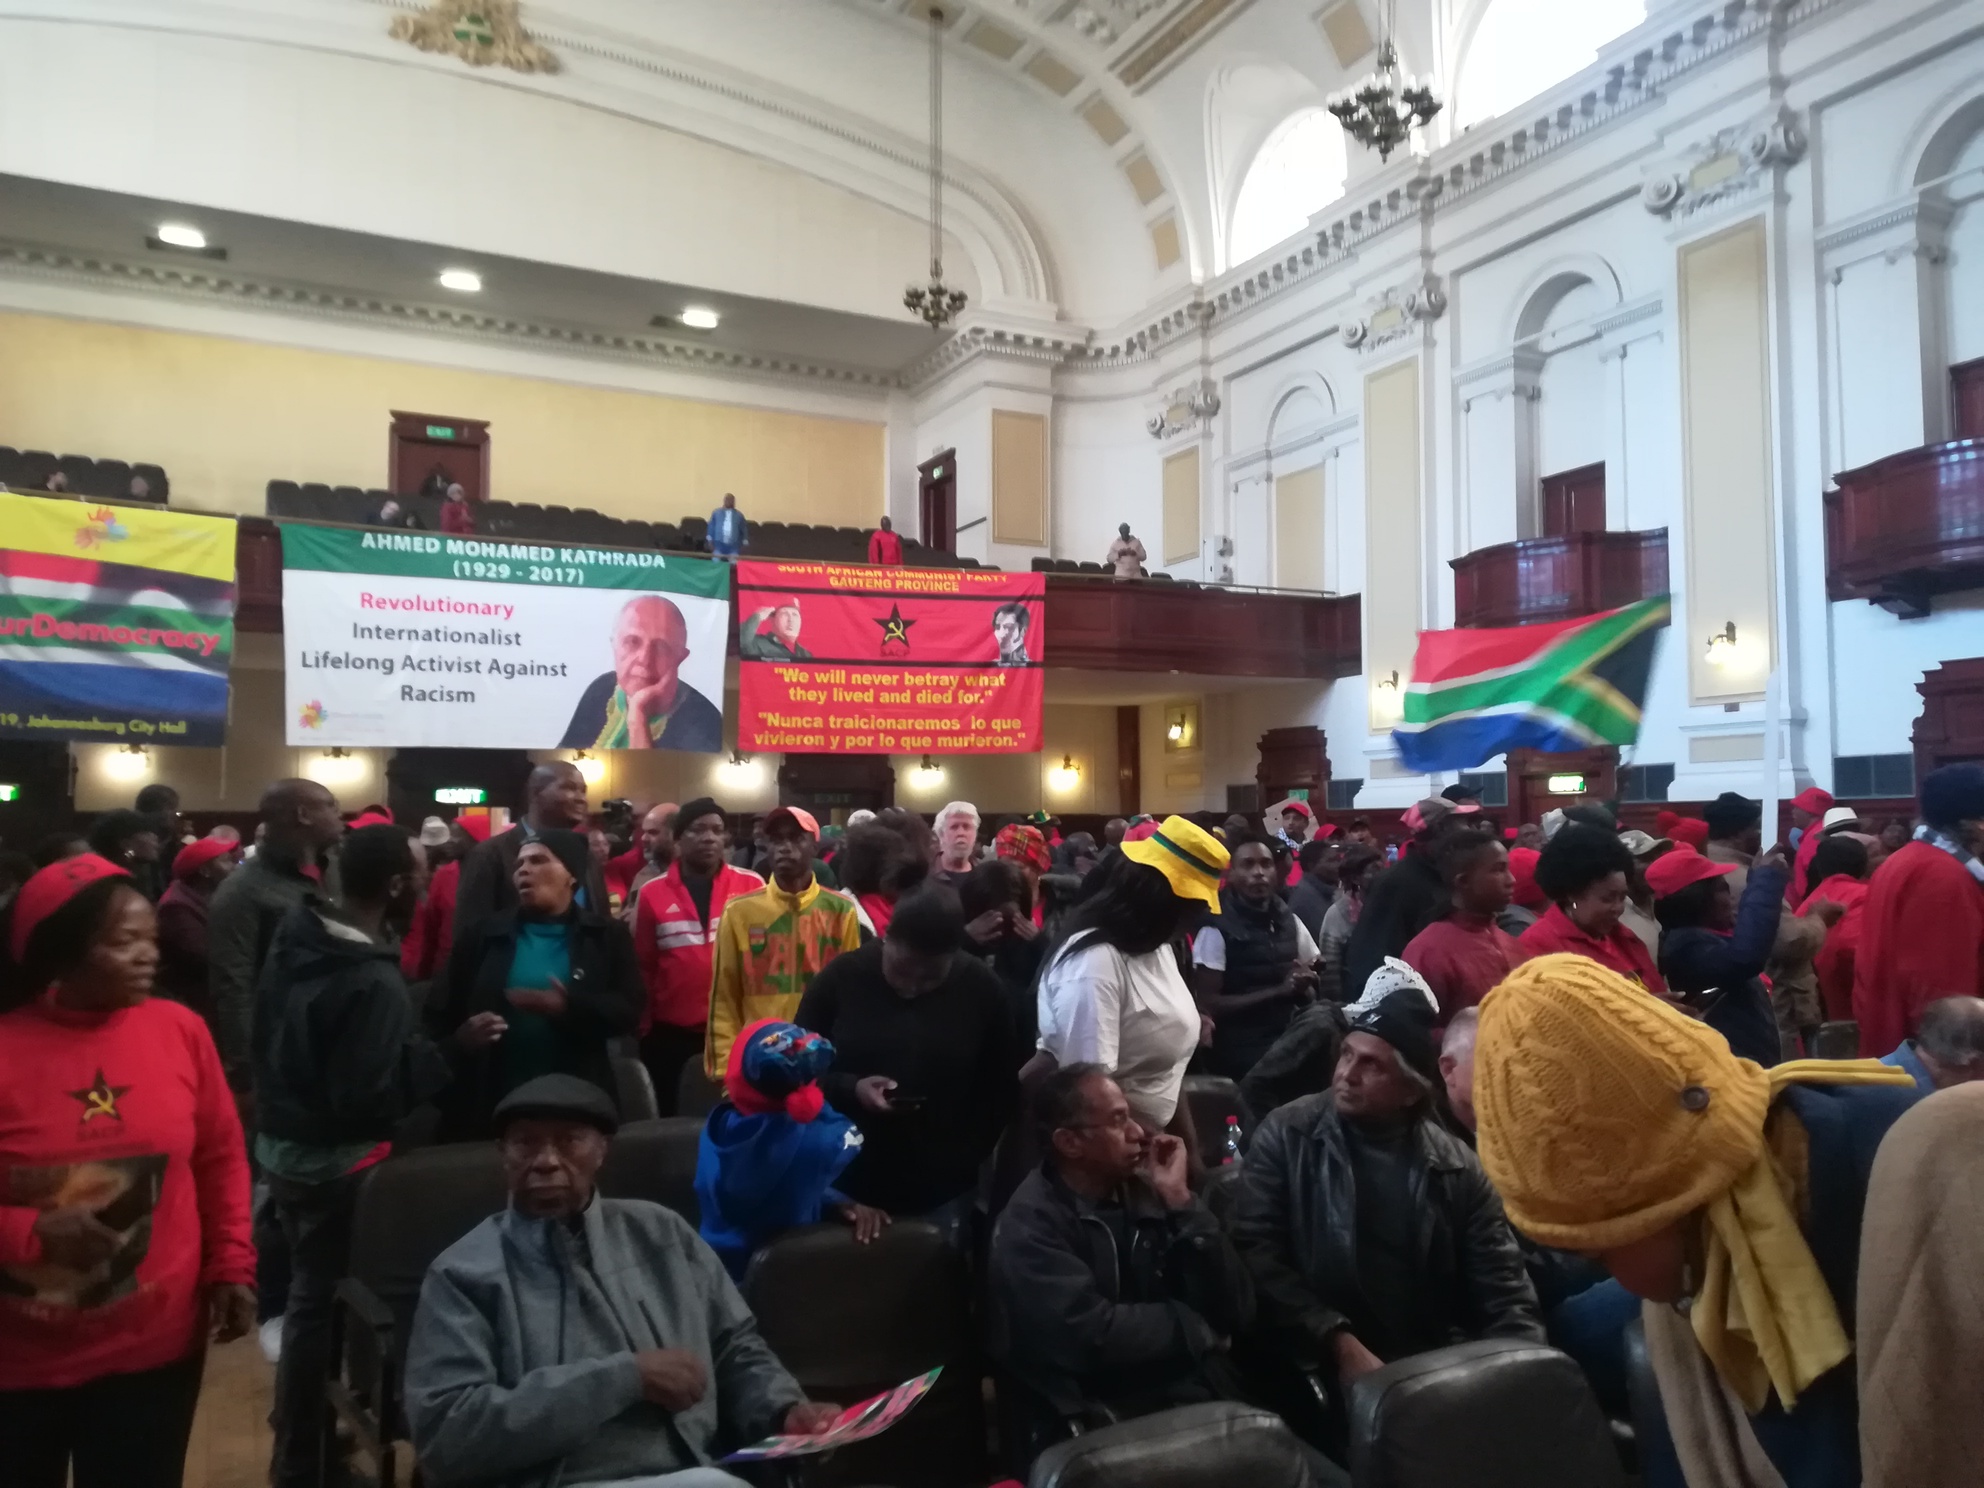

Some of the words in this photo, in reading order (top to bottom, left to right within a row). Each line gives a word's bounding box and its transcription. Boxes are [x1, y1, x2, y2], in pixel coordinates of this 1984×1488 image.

[361, 532, 442, 554] AHMED
[446, 539, 555, 562] MOHAMED
[560, 547, 666, 569] KATHRADA
[453, 559, 511, 579] (1929
[528, 565, 585, 585] 2017)
[829, 576, 892, 590] GAUTENG
[895, 579, 960, 592] PROVINCE
[360, 592, 515, 620] Revolutionary
[353, 622, 522, 646] Internationalist
[301, 651, 395, 675] Lifelong
[401, 655, 482, 674] Activist
[487, 658, 568, 680] Against
[774, 667, 809, 683] "We
[814, 670, 846, 684] will
[851, 673, 899, 686] never
[904, 671, 960, 689] betray
[964, 672, 1006, 686] what
[400, 684, 476, 703] Racism
[789, 686, 827, 705] they
[833, 687, 874, 703] lived
[879, 689, 911, 704] and
[916, 689, 953, 704] died
[958, 689, 993, 705] for."
[758, 711, 824, 729] "Nunca
[828, 714, 961, 730] traicionaremos
[971, 715, 987, 730] lo
[991, 718, 1022, 733] que
[754, 730, 825, 746] vivieron
[829, 735, 840, 750] y
[845, 735, 875, 750] por
[879, 733, 895, 748] lo
[900, 736, 932, 751] que
